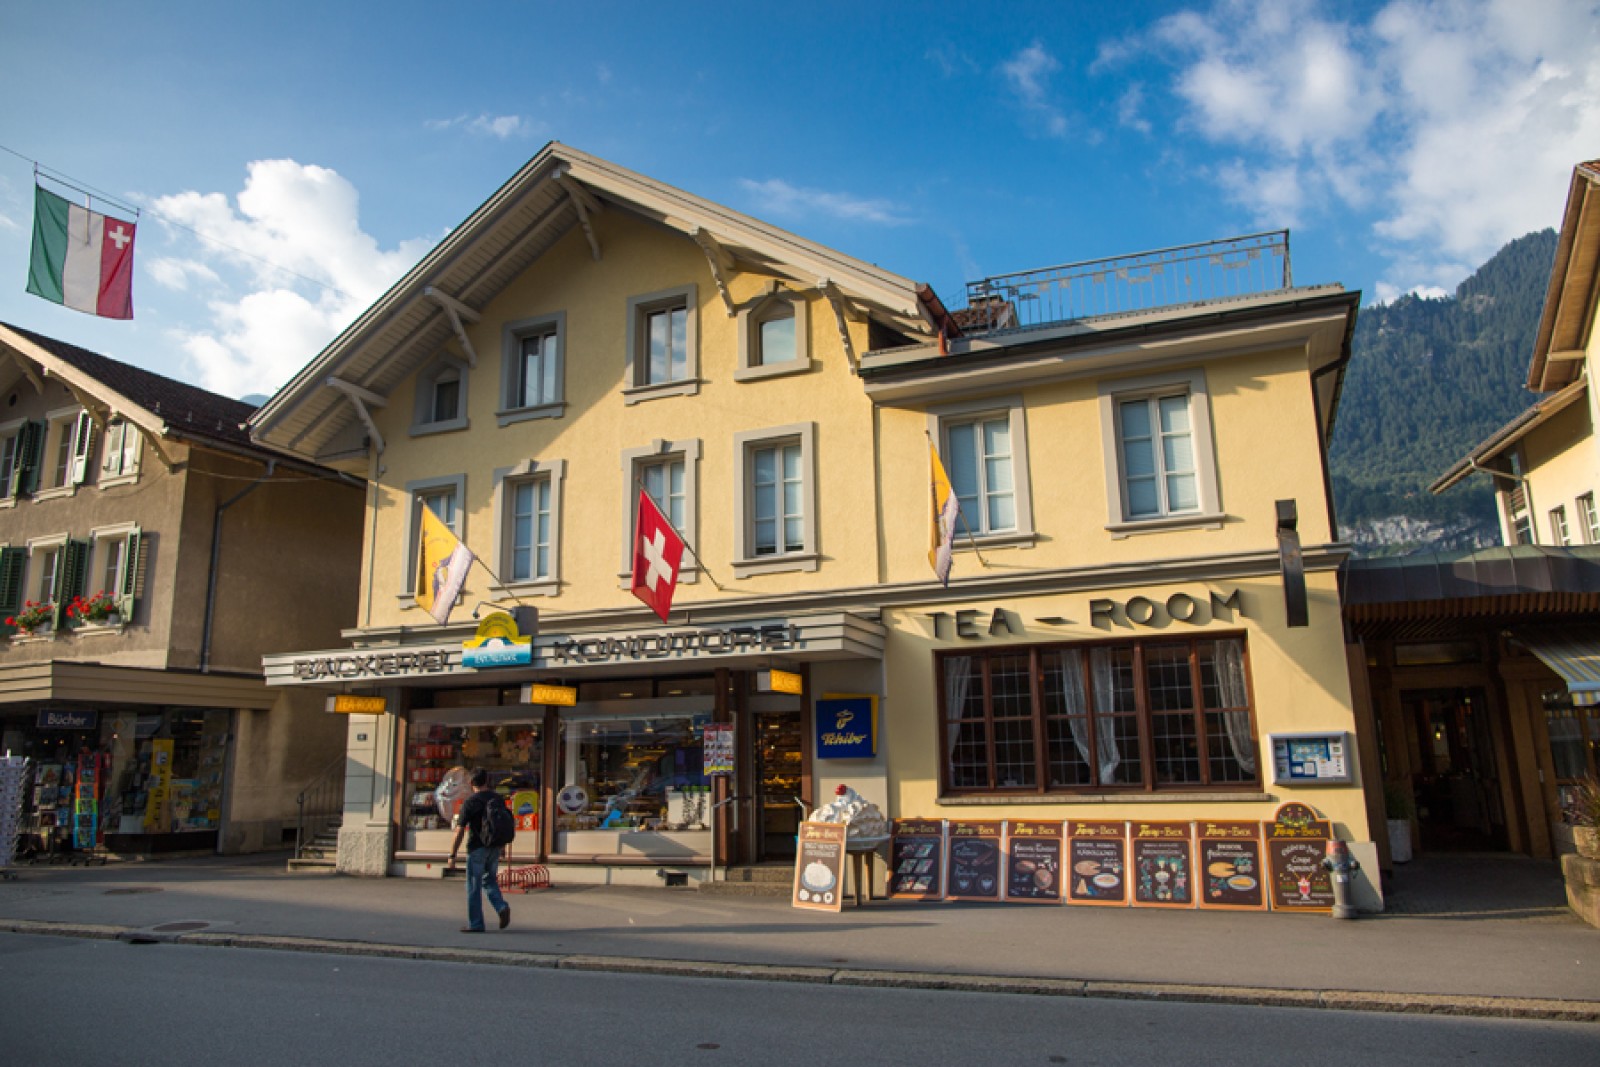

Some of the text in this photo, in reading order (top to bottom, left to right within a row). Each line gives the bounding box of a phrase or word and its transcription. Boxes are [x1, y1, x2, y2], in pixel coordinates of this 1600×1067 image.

[926, 607, 1012, 638] TEA
[1089, 588, 1245, 627] ROOM
[554, 623, 799, 661] KONDITOREI
[47, 712, 87, 726] Bücher
[821, 732, 867, 746] Tchibo
